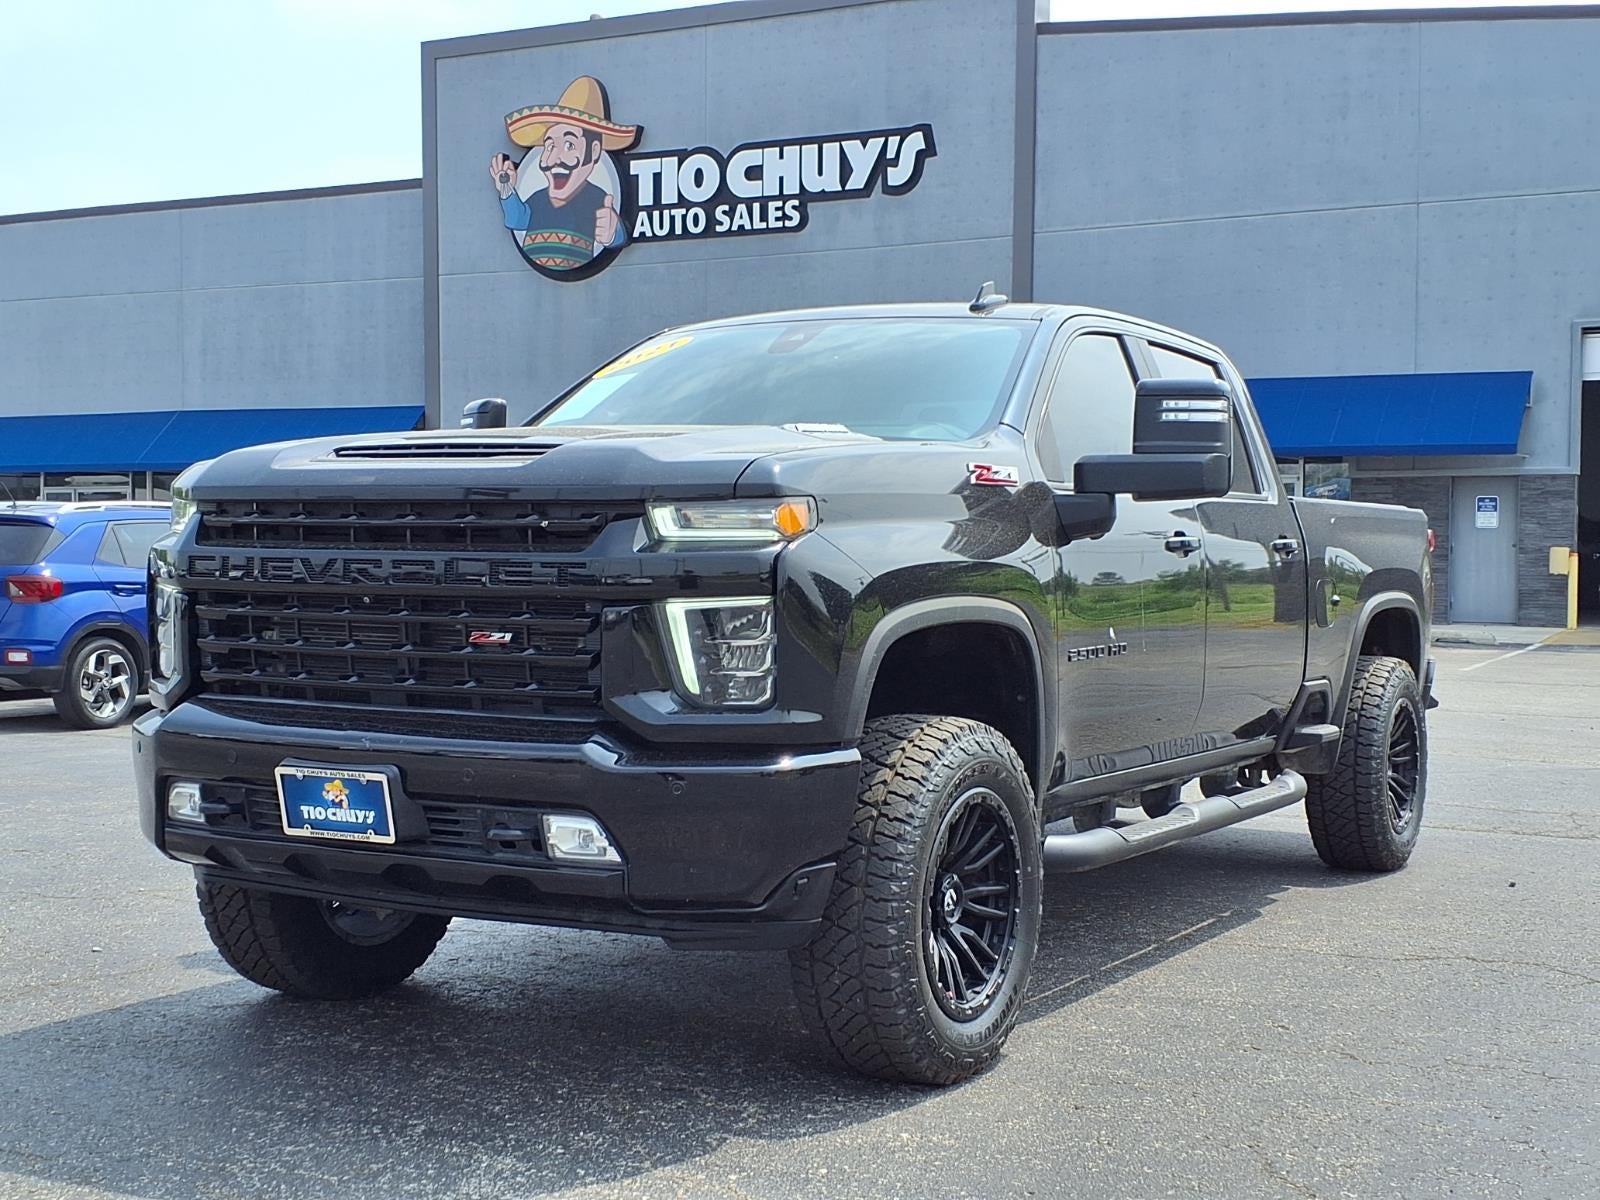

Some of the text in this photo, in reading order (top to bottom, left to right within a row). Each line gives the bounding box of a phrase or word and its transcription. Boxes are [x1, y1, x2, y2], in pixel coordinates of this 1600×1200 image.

[630, 131, 926, 206] TIO CHUY'S
[632, 199, 801, 238] AUTO SALES
[187, 555, 587, 588] CHEVROLET
[1067, 642, 1127, 662] 2500 HD
[300, 805, 375, 824] TIO CHUY'S
